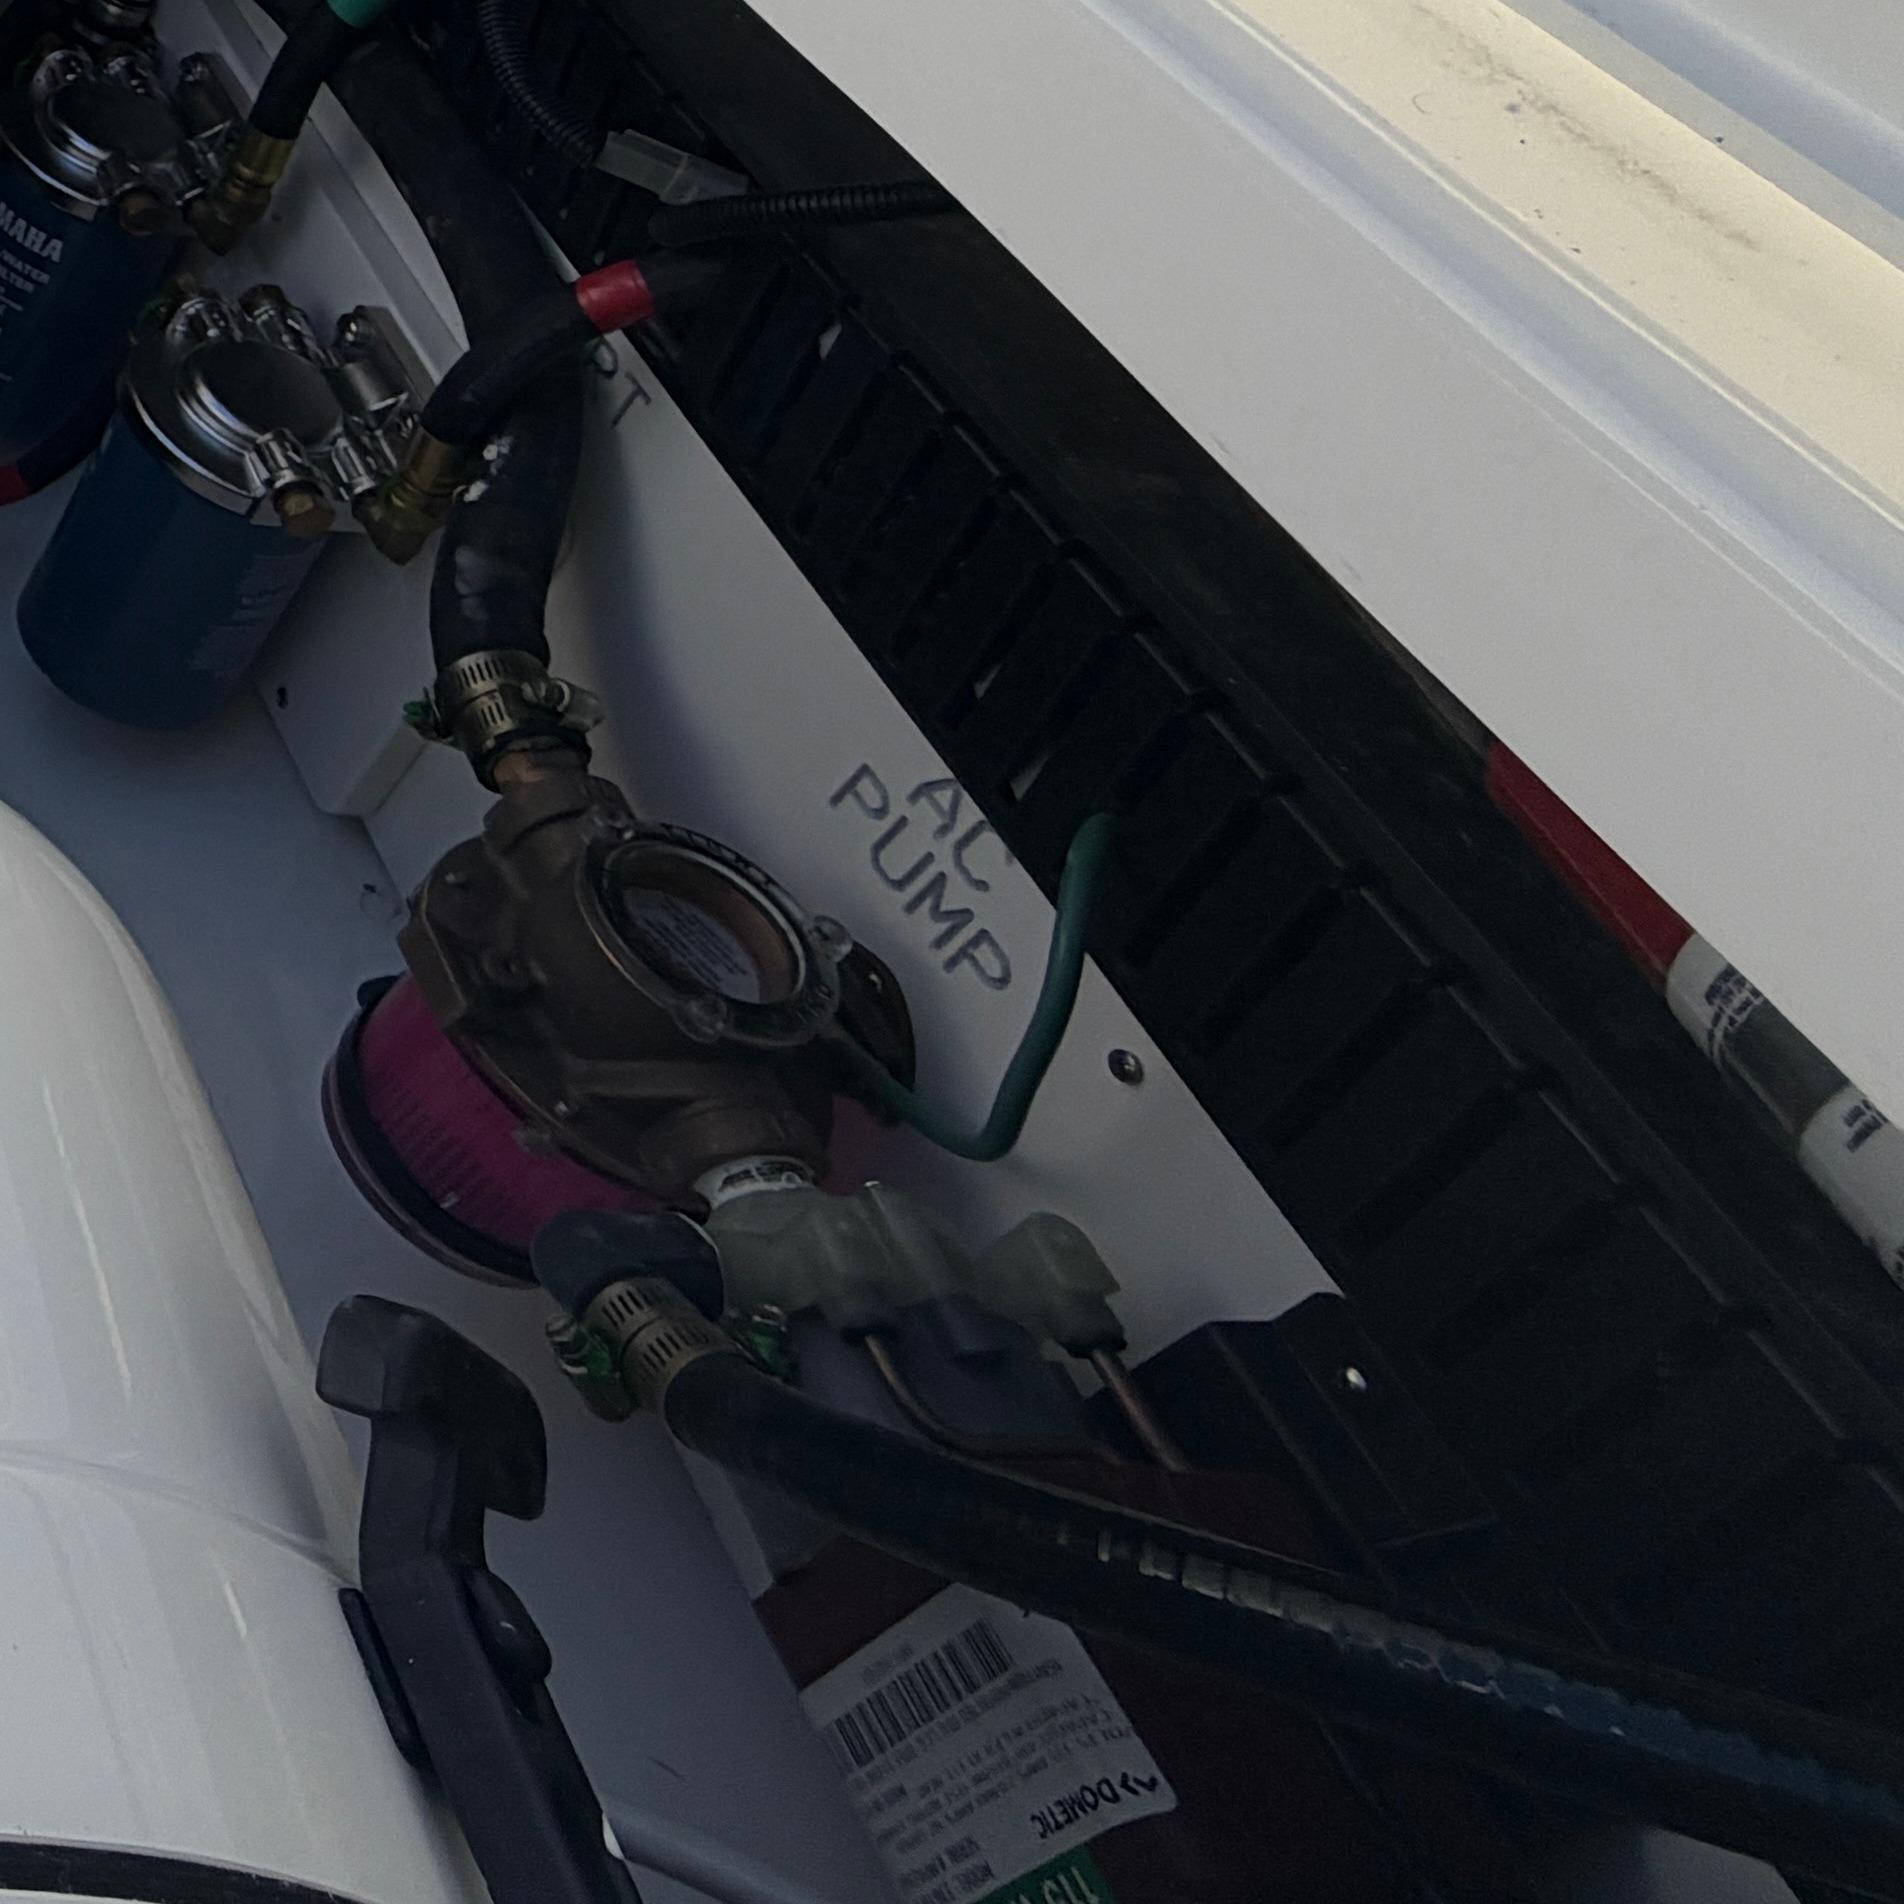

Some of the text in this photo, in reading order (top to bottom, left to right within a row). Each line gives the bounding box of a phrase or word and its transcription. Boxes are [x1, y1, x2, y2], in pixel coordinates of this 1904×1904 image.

[829, 762, 1012, 991] PUMP
[906, 777, 995, 893] AC
[1030, 1776, 1122, 1840] DOMETIC
